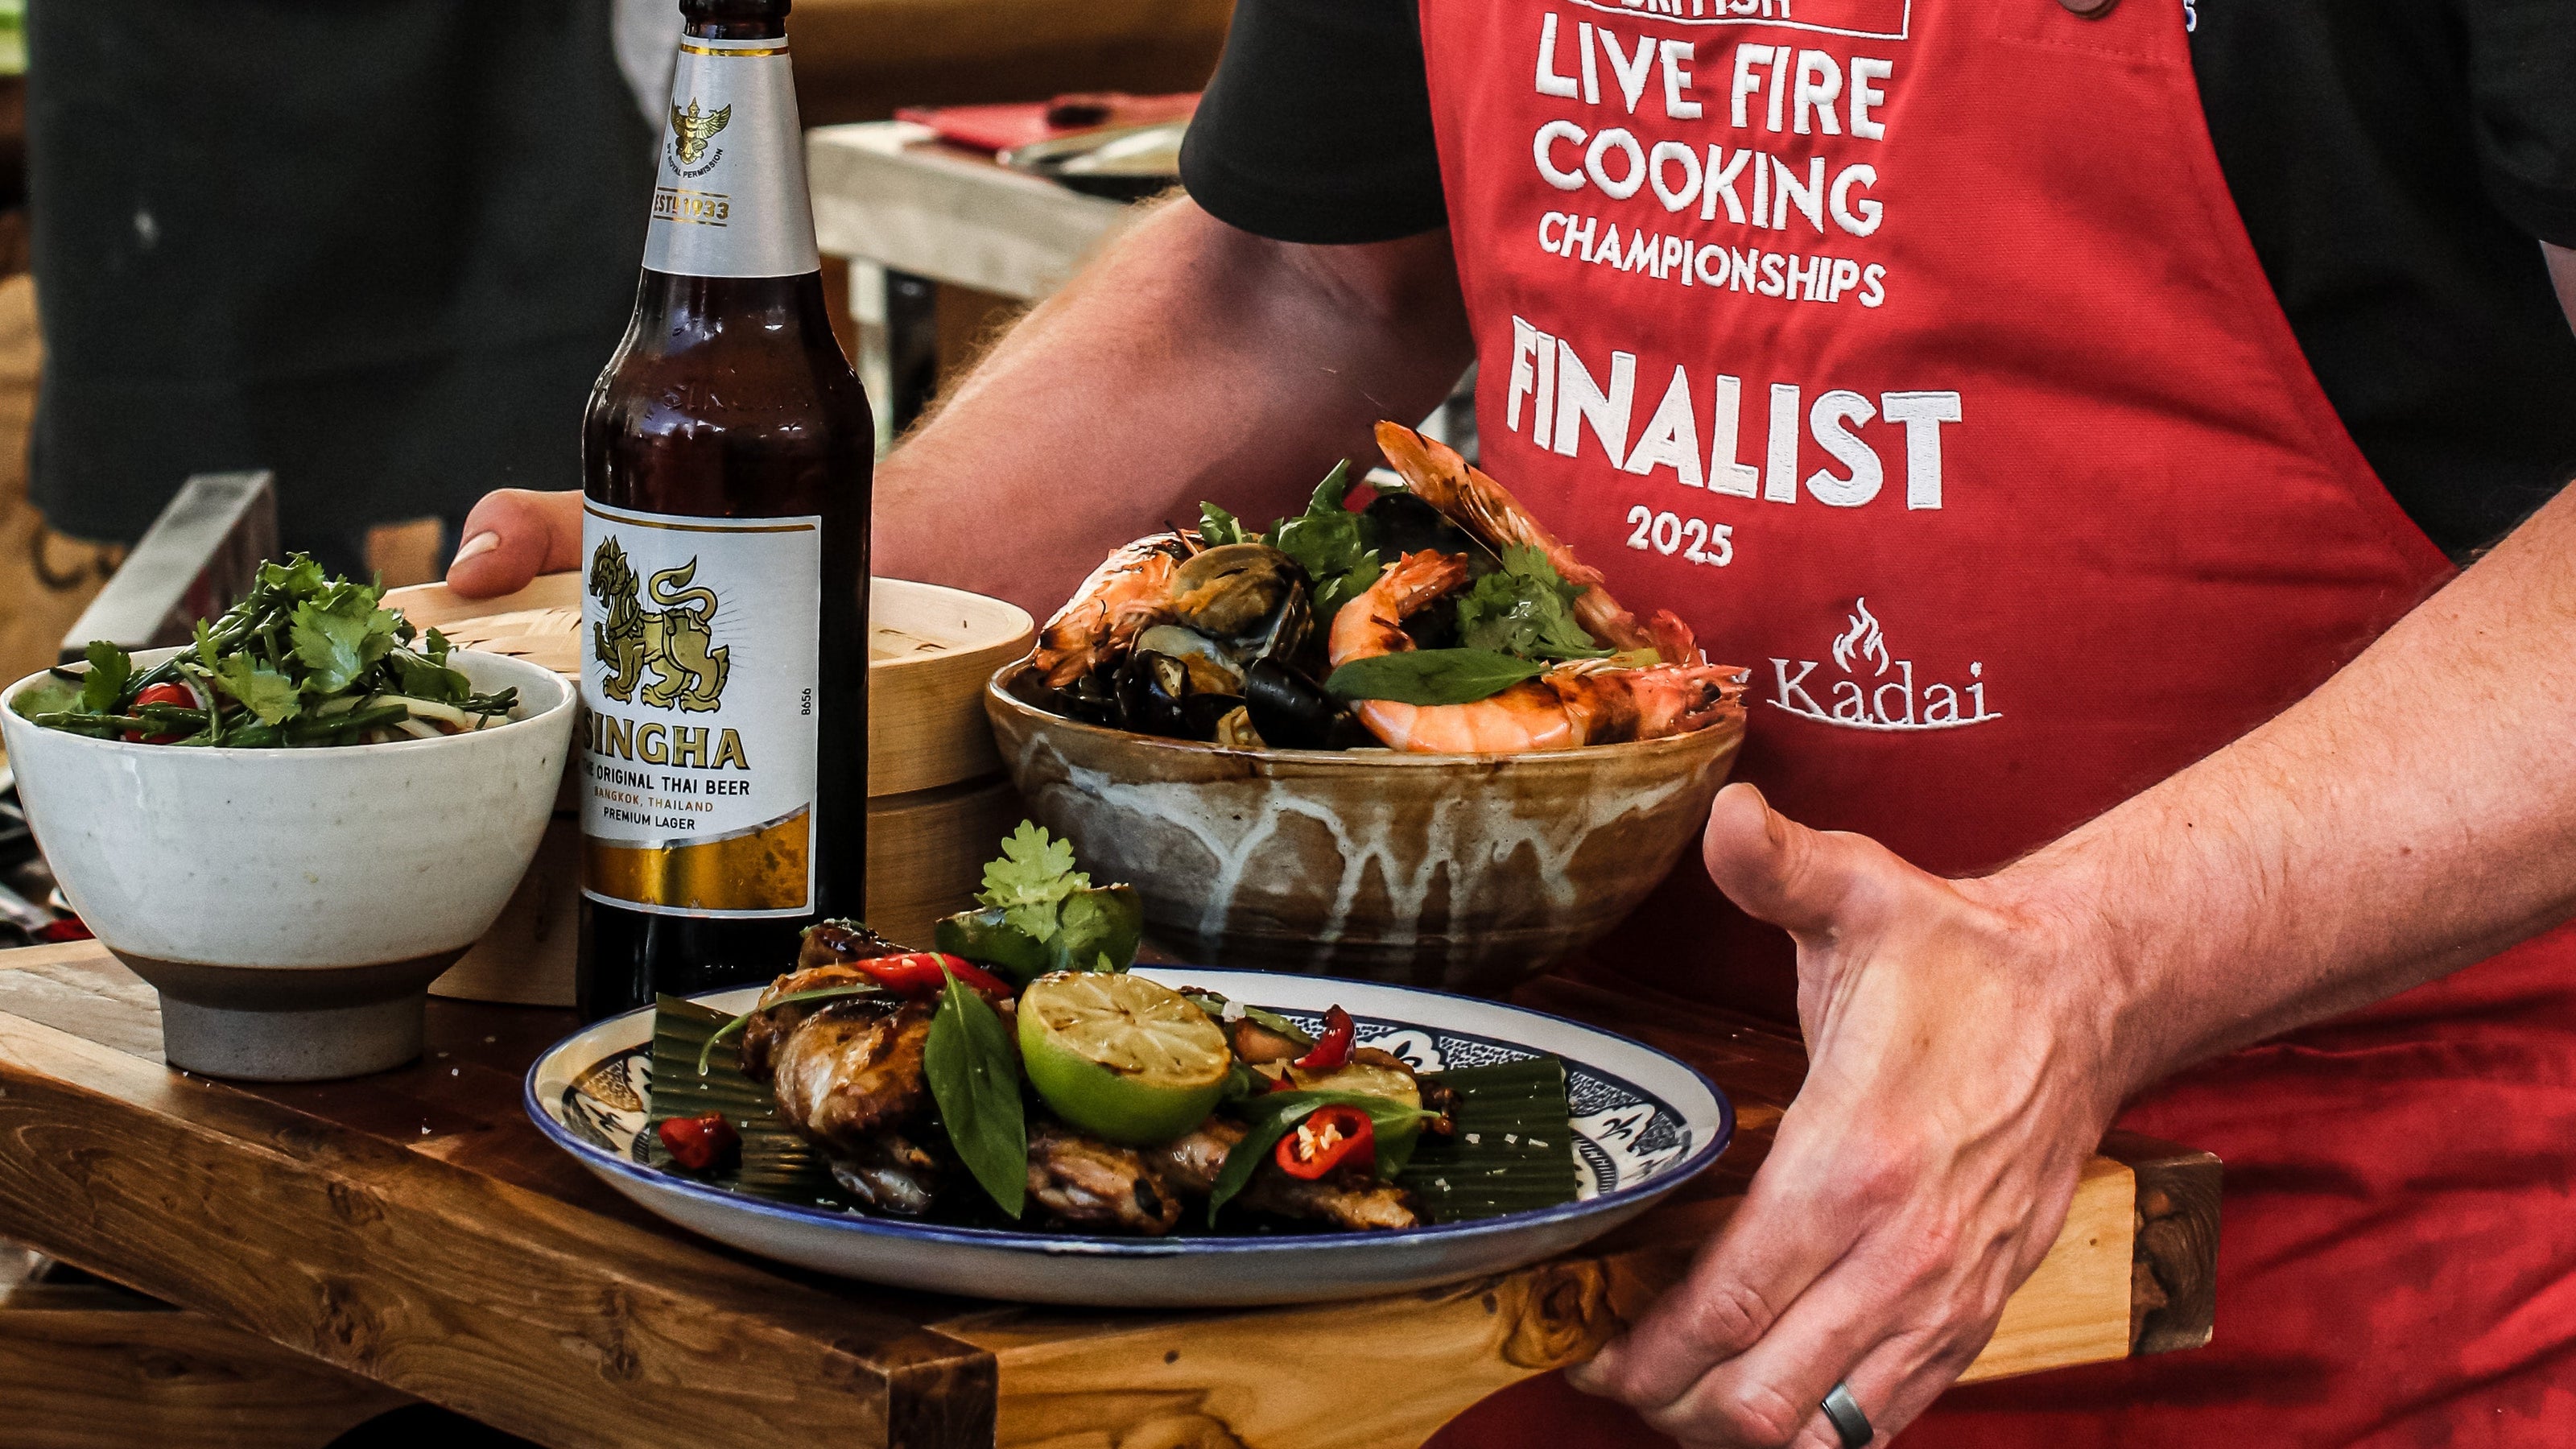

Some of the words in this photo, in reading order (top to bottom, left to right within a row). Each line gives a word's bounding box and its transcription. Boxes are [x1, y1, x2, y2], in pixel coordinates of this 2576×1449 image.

[1534, 11, 1703, 120] LIVE
[1730, 43, 1894, 142] FIRE
[667, 155, 682, 177] ROYAL
[683, 147, 724, 178] PERMISSION
[1533, 119, 1885, 238] COOKING
[683, 197, 729, 220] 1933
[1538, 210, 1887, 308] CHAMPIONSHIPS
[1506, 315, 1963, 511] FINALIST
[1626, 504, 1734, 568] 2025
[801, 687, 811, 716] 8656
[1767, 657, 1987, 725] Kadai
[584, 706, 751, 770] SINGHA
[594, 786, 643, 807] BANGKOK,
[648, 797, 714, 812] THAILAND
[597, 765, 654, 790] ORIGINAL
[662, 776, 698, 794] THAI
[706, 779, 750, 795] BEER
[604, 806, 650, 826] PREMIUM
[655, 815, 696, 830] LAGER
